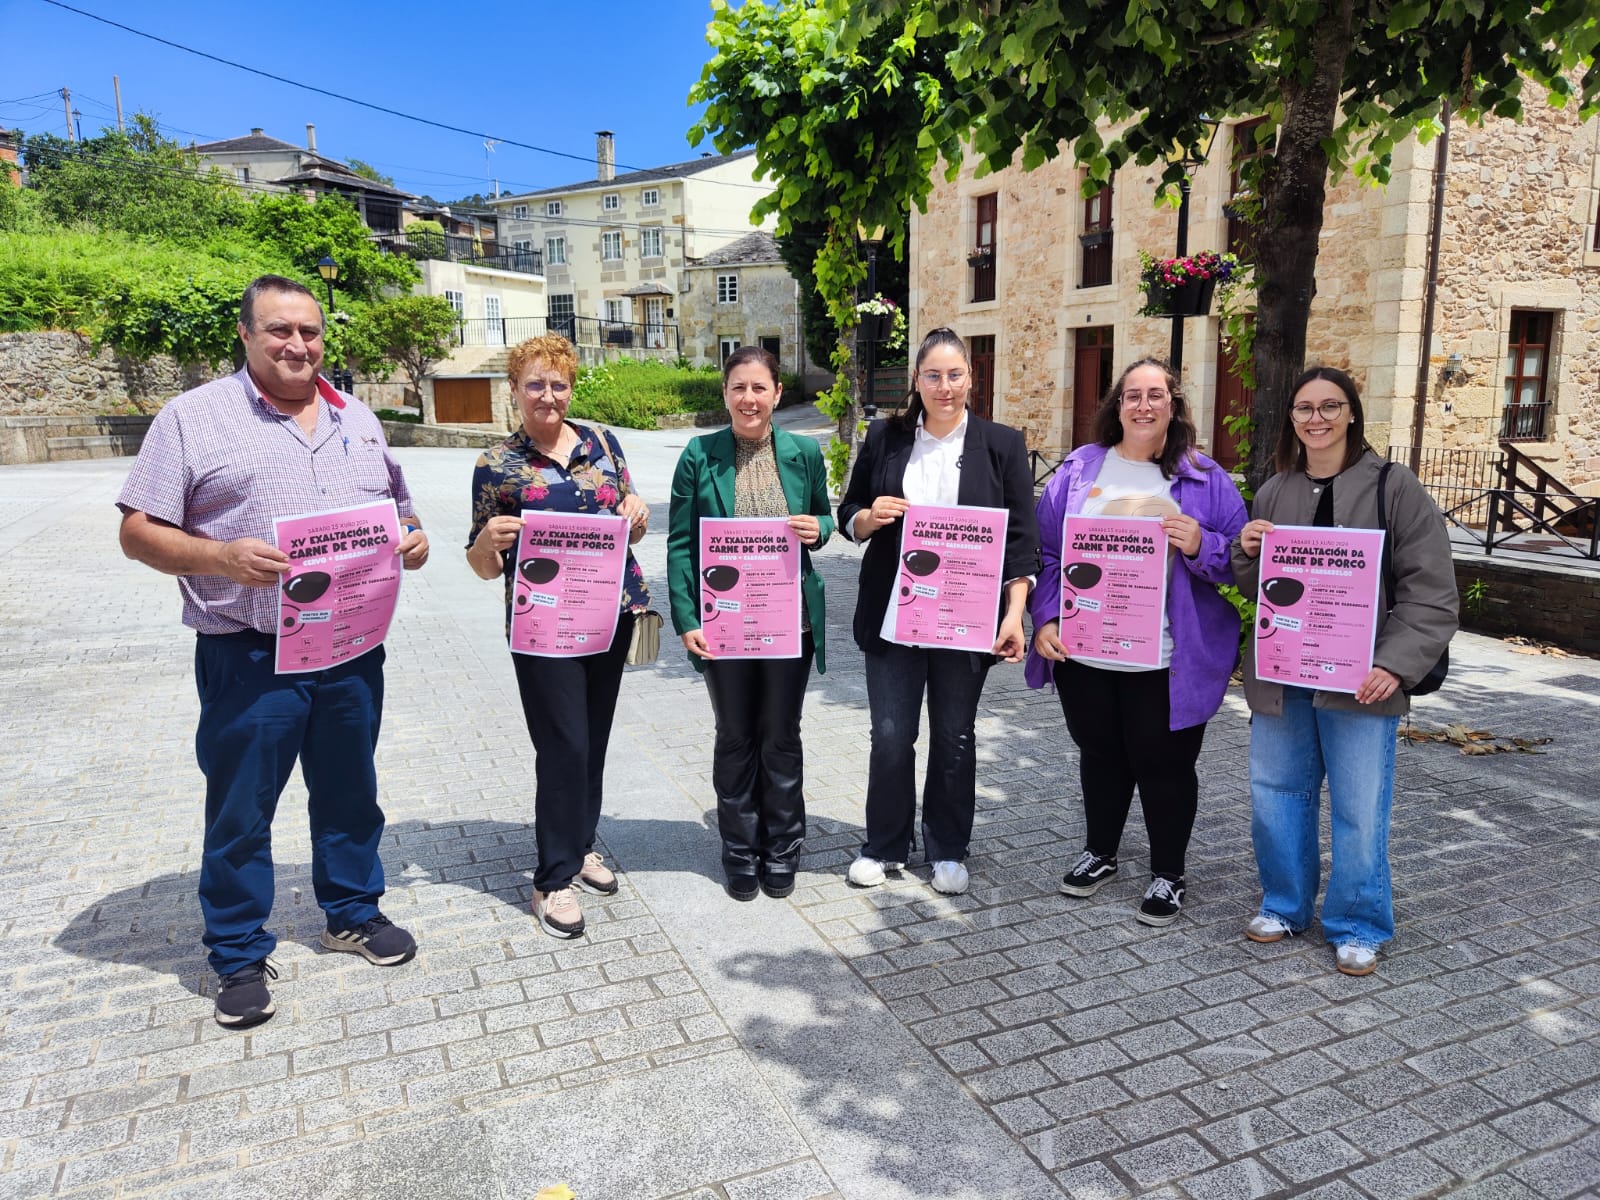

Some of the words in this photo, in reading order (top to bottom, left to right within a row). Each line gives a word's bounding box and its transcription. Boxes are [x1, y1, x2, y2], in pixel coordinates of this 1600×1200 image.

[930, 522, 978, 532] EXALTACIÓN
[291, 538, 306, 548] XV
[310, 527, 369, 544] EXALTACIÓN
[374, 525, 385, 533] DA
[549, 531, 600, 540] EXALTACIÓN
[725, 535, 773, 543] EXALTACIÓN
[913, 530, 942, 539] CARNE
[946, 532, 958, 541] DE
[962, 534, 993, 543] PORCO
[1089, 535, 1139, 543] EXALTACIÓN
[290, 545, 328, 560] CARNE
[333, 542, 347, 552] DE
[352, 535, 388, 549] PORCO
[530, 539, 562, 547] CARNE
[582, 541, 615, 550] PORCO
[1072, 543, 1103, 551] CARNE
[1107, 544, 1119, 552] DE
[1123, 545, 1155, 554] PORCO
[1292, 547, 1347, 557] EXALTACIÓN
[1272, 555, 1306, 565] CARNE
[1310, 558, 1323, 566] DE
[1328, 559, 1365, 568] PORCO
